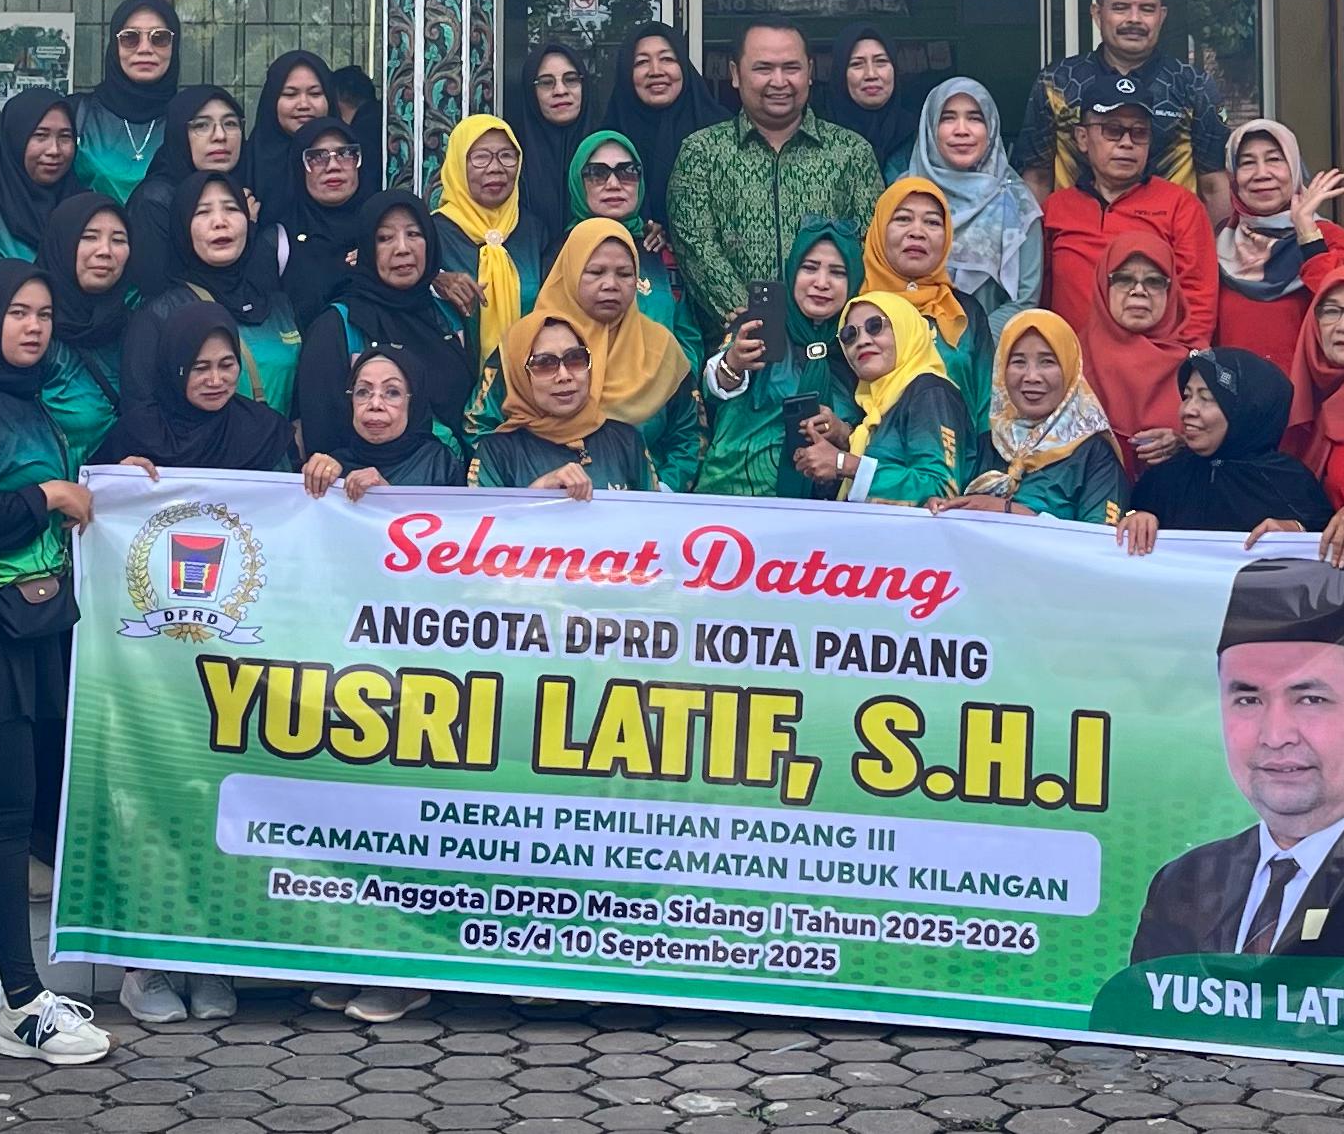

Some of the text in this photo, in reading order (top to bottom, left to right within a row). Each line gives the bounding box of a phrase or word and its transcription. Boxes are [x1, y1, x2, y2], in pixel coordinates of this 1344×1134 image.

[383, 512, 960, 618] Selamat Datang
[164, 609, 218, 625] DPRD
[349, 605, 988, 680] ANGGOTA DPRD KOTA PADANG
[197, 656, 1111, 812] YUSRI LATIF, S.H.I
[247, 821, 1068, 902] KECAMATAN PAUH DAN KECAMATAN LUBUK KILANGAN
[420, 800, 896, 852] DAERAH PEMILIHAN PADANG III
[272, 873, 1036, 951] Reses Anggota DPRD Masa Sidang I Tahun 2025-2026
[463, 924, 838, 971] 05 s/d 10 September 2025
[1145, 971, 1261, 1022] YUSRI
